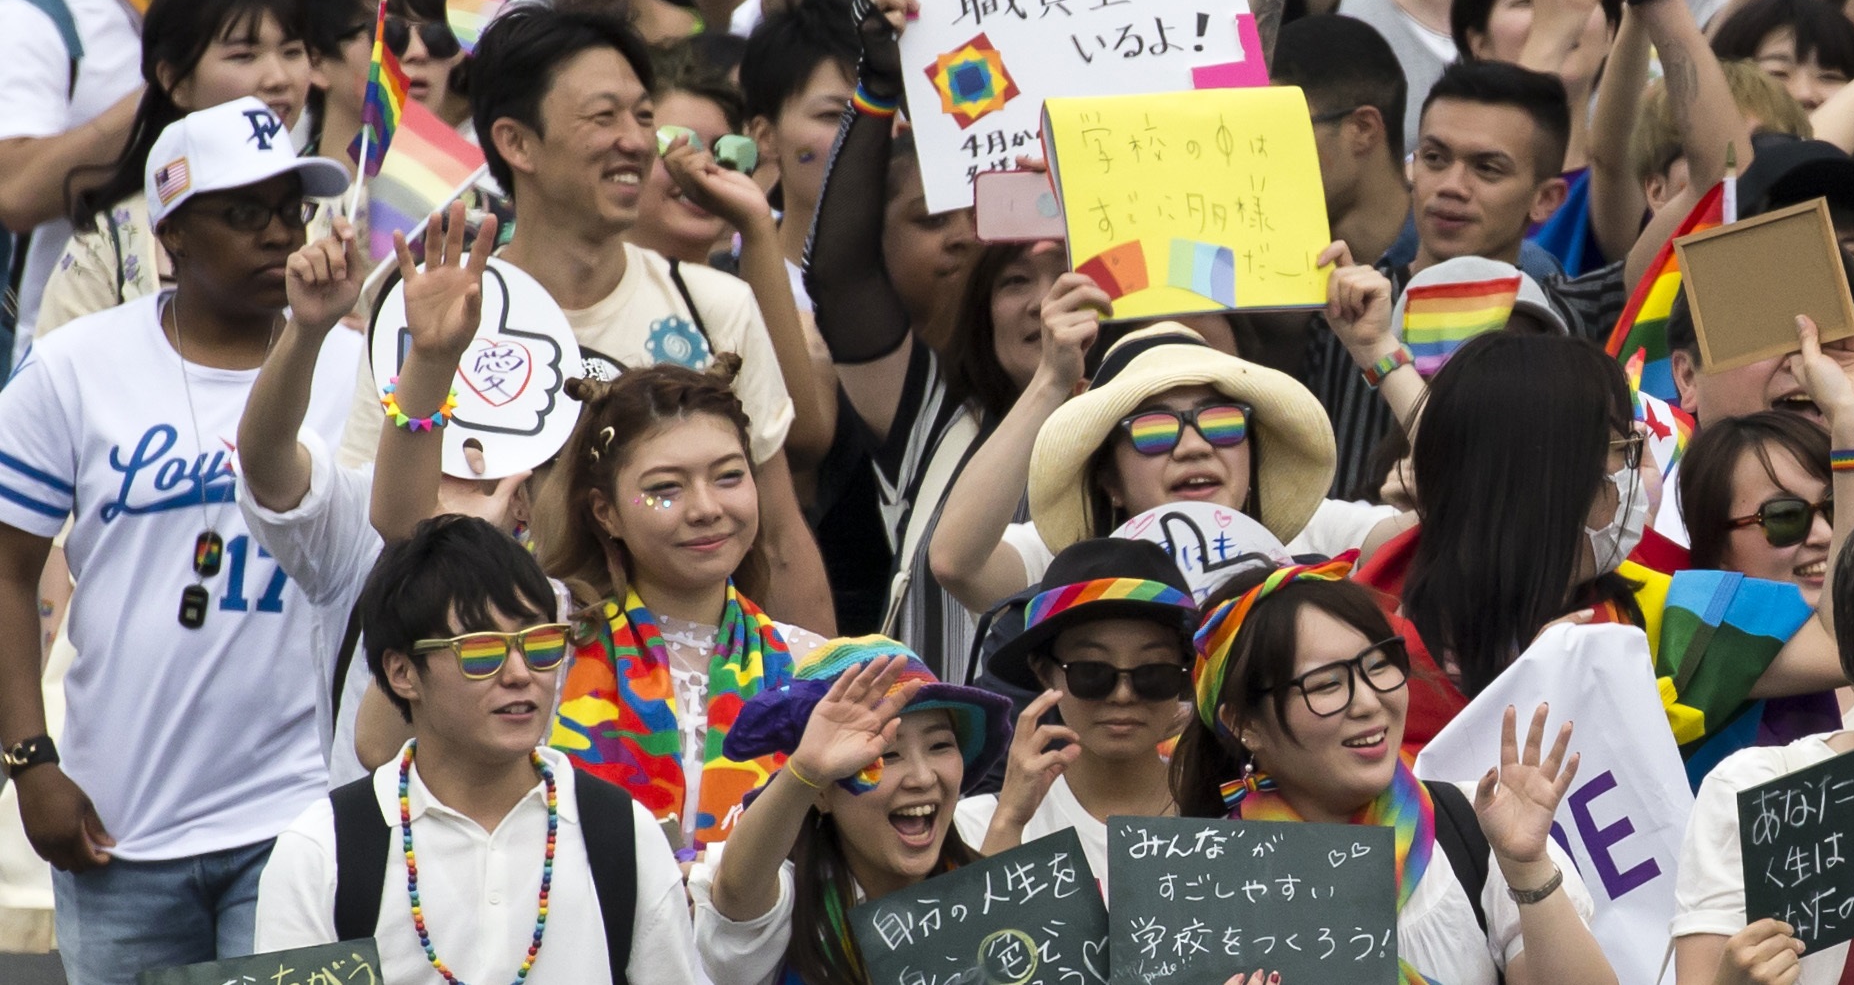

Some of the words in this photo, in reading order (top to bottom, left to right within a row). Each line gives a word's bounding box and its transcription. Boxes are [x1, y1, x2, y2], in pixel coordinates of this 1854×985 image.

[1071, 12, 1210, 64] いるよ!
[960, 129, 1041, 158] 4月か
[101, 423, 236, 524] Lou
[219, 534, 288, 613] 17
[872, 852, 1081, 951] 自分の人生を
[1158, 872, 1335, 904] すごしやすい
[1130, 916, 1391, 961] 学校をつくろう!
